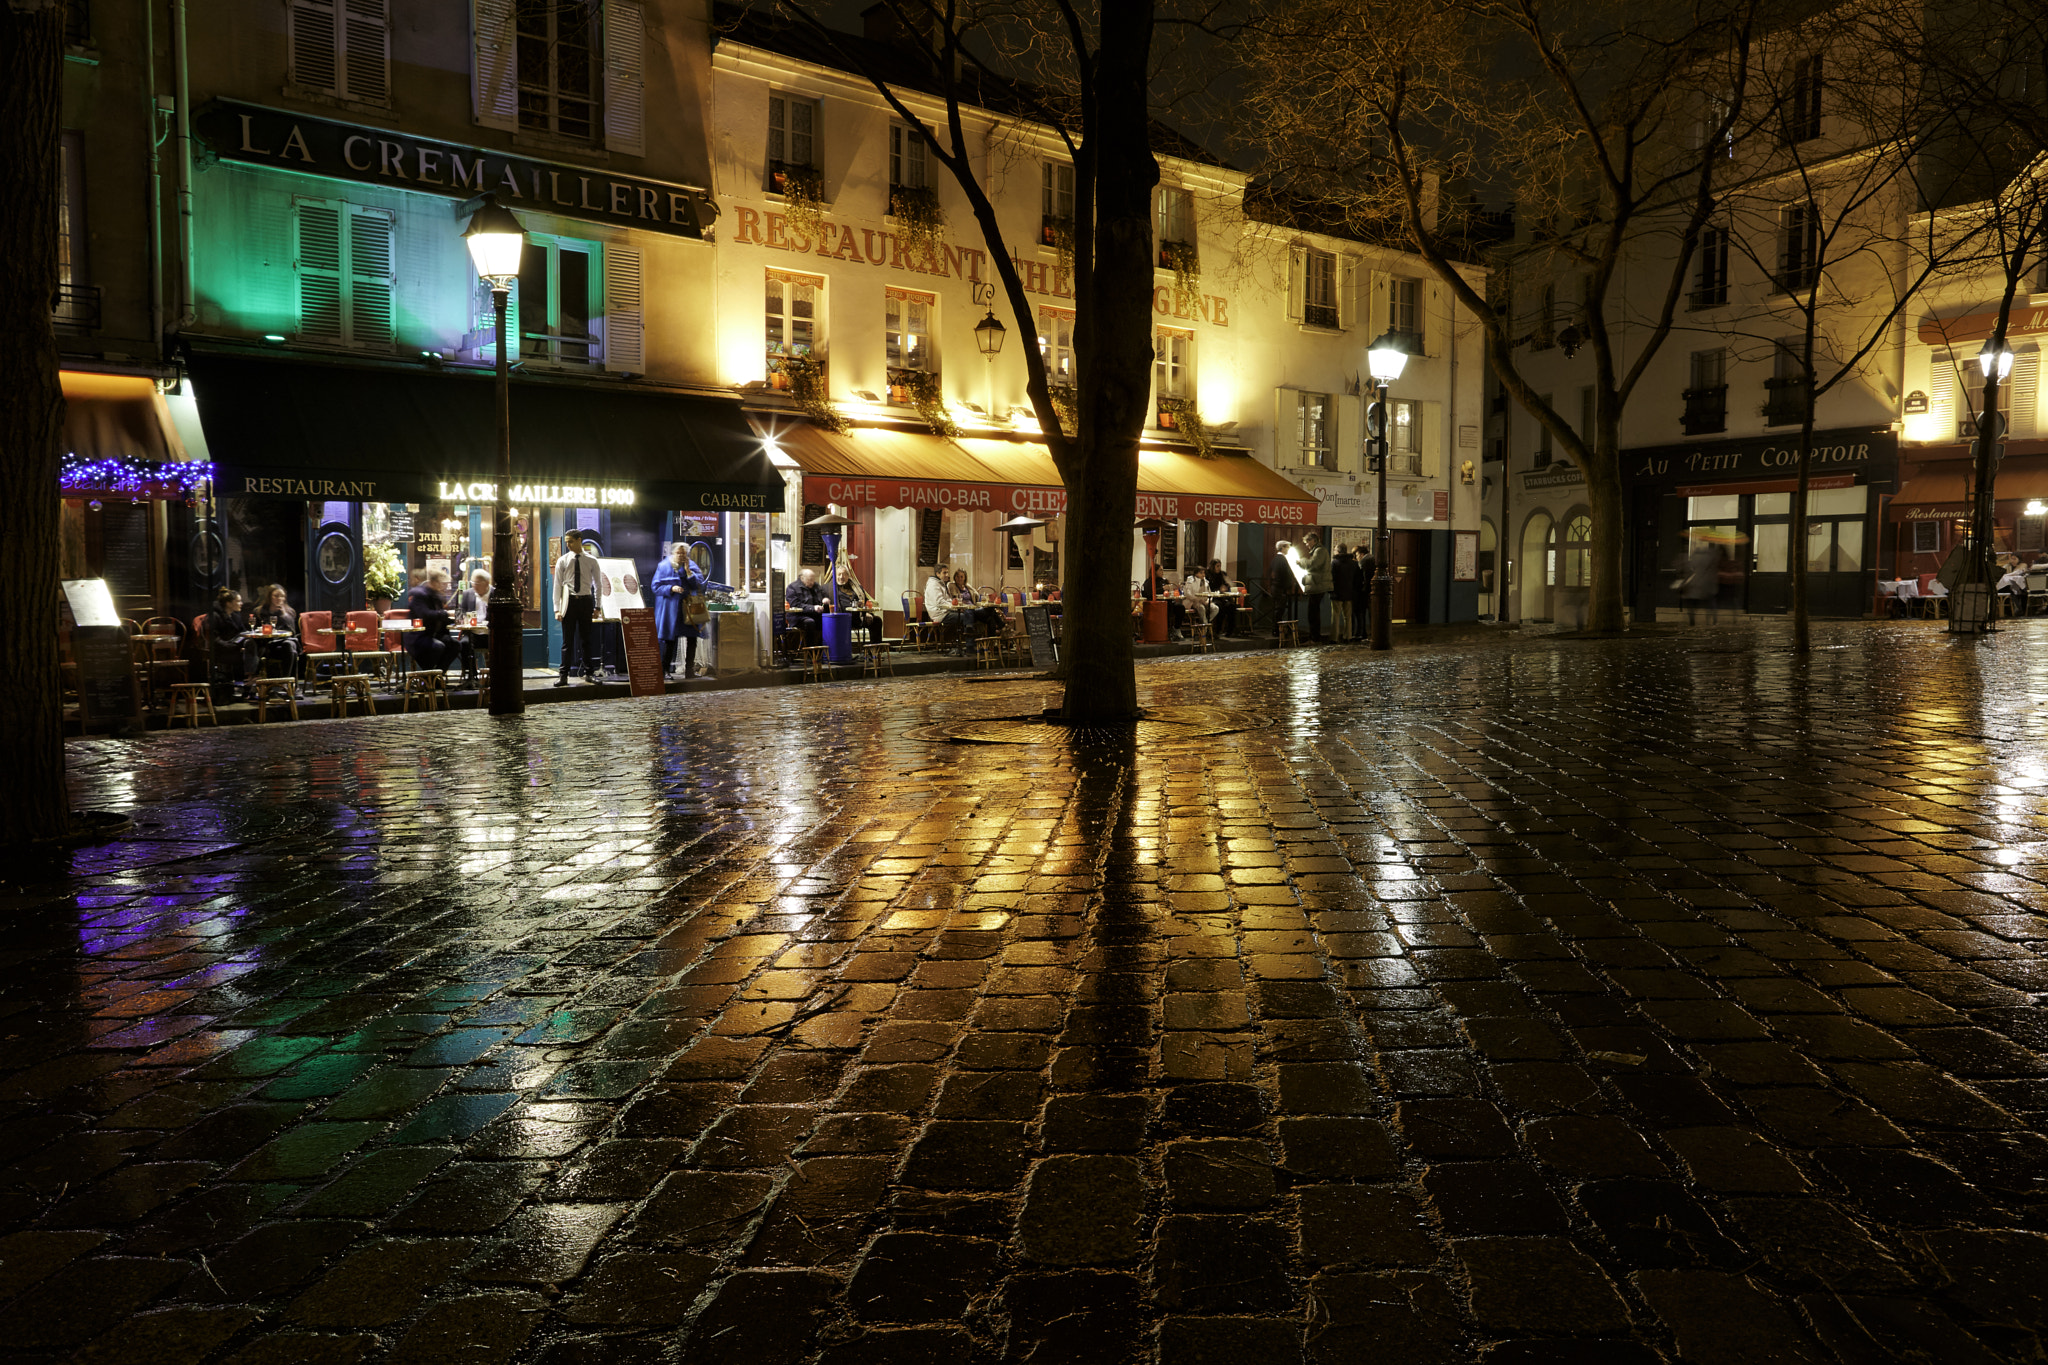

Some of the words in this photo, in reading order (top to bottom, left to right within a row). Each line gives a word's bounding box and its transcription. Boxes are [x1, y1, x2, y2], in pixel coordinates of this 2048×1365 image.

[238, 113, 317, 165] LA
[343, 134, 691, 227] CREMAILLERE
[734, 205, 986, 284] RESTAURANT
[1153, 285, 1229, 328] GENE
[766, 271, 787, 281] CHEZ
[790, 274, 822, 286] EUGENE
[906, 293, 935, 303] EUGENE
[1636, 456, 1669, 476] AU
[1684, 452, 1742, 472] PETIT
[244, 477, 377, 497] RESTAURANT
[1525, 474, 1566, 487] STARBUCKS
[439, 482, 466, 500] LA
[467, 483, 597, 504] CRMAILLERE
[600, 487, 634, 505] 1900
[700, 492, 767, 508] CABARET
[828, 483, 877, 502] CAFE
[899, 487, 990, 507] PIANO-BAR
[1134, 496, 1178, 516] ENE
[1194, 501, 1244, 518] CREPES
[1258, 504, 1303, 520] GLACES
[1905, 507, 1976, 520] Restaurant
[427, 544, 460, 553] SALON
